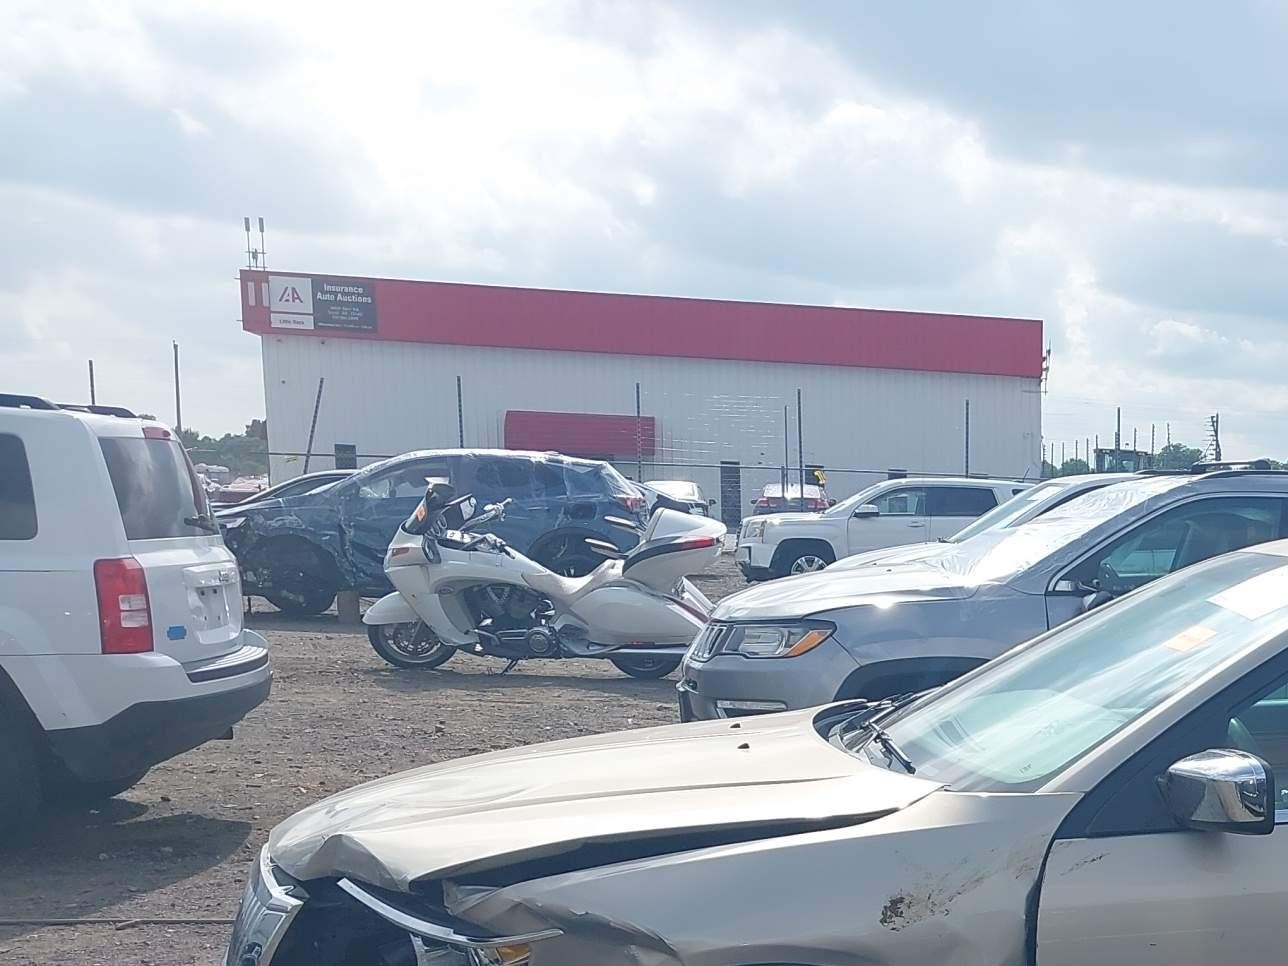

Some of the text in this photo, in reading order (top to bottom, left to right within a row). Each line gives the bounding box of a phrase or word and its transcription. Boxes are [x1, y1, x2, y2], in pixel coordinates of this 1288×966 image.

[323, 283, 364, 294] Insurance
[317, 291, 372, 304] Auto Auctions
